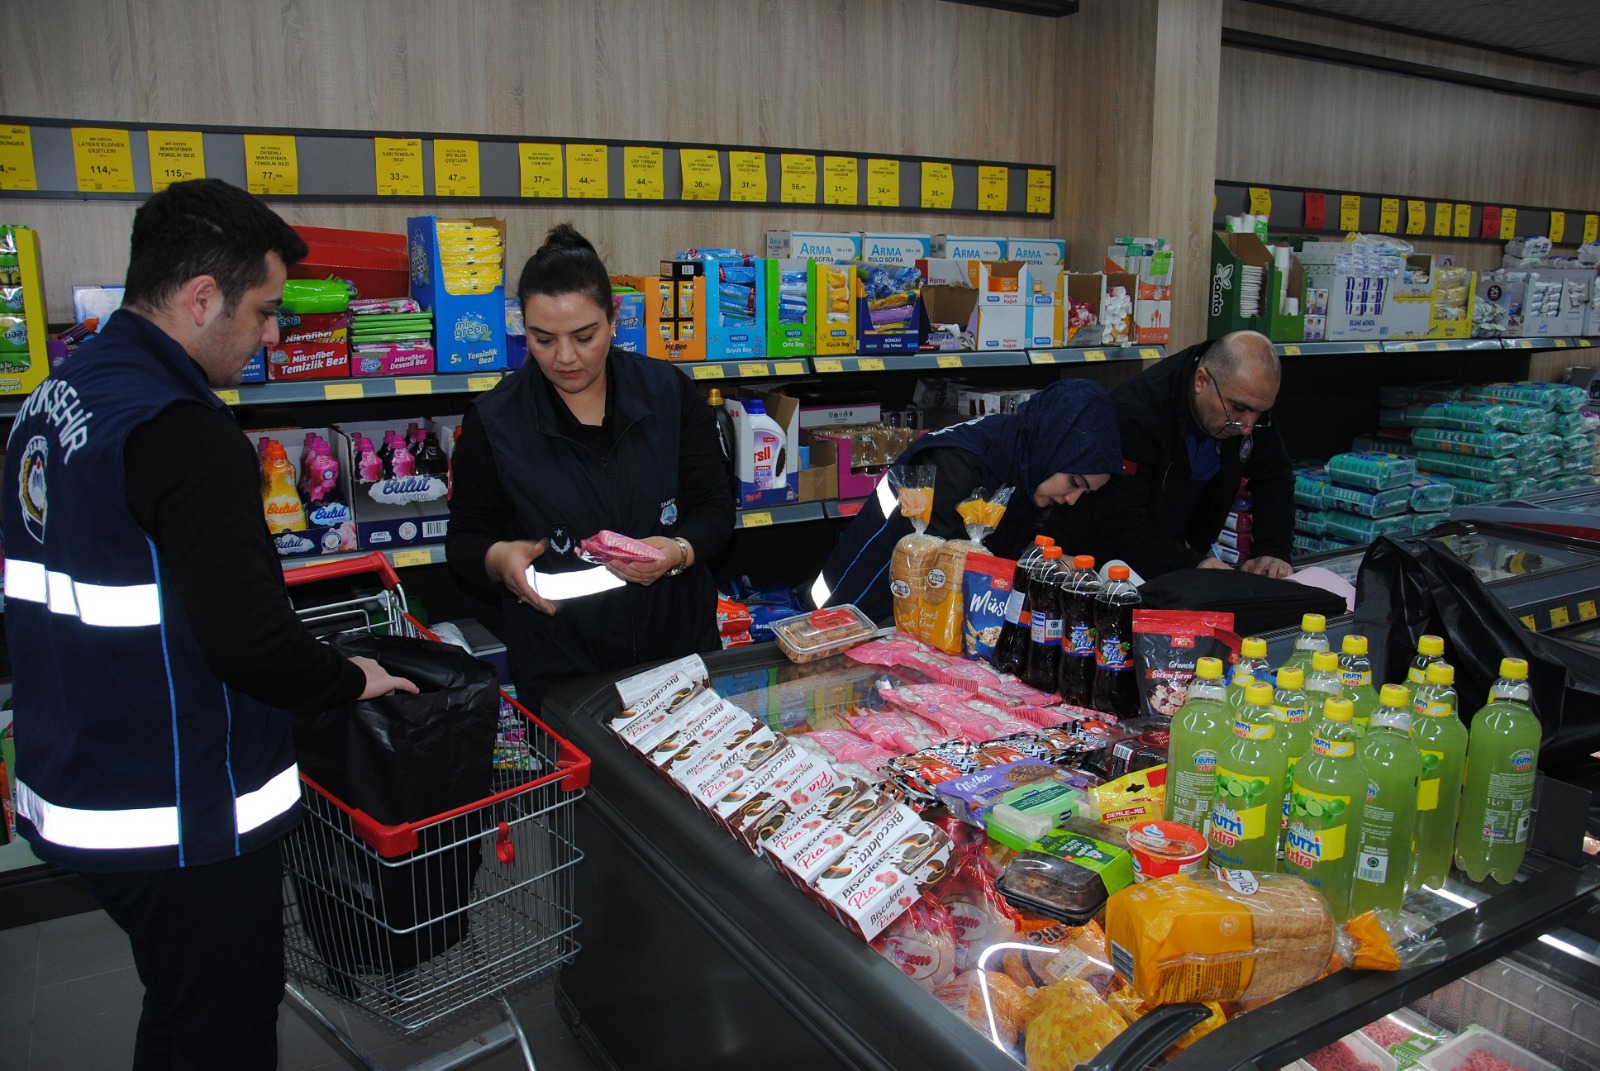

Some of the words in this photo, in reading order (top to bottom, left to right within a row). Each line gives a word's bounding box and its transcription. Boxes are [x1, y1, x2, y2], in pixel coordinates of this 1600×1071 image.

[800, 242, 832, 255] ARMA
[871, 244, 901, 256] ARMA
[953, 246, 981, 258] ARMA
[1015, 247, 1041, 259] ARMA
[1212, 275, 1223, 316] santa
[454, 324, 489, 341] green
[292, 350, 336, 363] Mikrofiber
[394, 353, 426, 363] Mikrofiber
[468, 349, 498, 361] Temizlik
[478, 356, 494, 365] Bezi
[742, 346, 752, 355] Boy
[281, 359, 324, 375] Temizlik
[326, 354, 348, 367] Bezi
[390, 359, 415, 370] Desenli
[416, 358, 428, 366] Bez
[382, 475, 431, 495] Bulut
[266, 502, 300, 514] Bulut
[315, 507, 348, 520] Bulut
[276, 538, 304, 549] Bulut
[1168, 660, 1195, 670] Granola
[642, 674, 680, 710] Biscolata
[625, 701, 666, 733] Biscolata
[684, 702, 725, 742] Biscolata
[627, 722, 650, 738] Pia
[685, 748, 717, 777] Biscolata
[692, 762, 709, 776] Pia
[753, 747, 798, 793] Biscolata
[783, 762, 814, 794] Biscolata
[807, 770, 834, 793] Pia
[955, 773, 994, 792] Milka
[701, 779, 727, 799] Pia
[771, 802, 819, 844] Biscolata
[774, 829, 804, 851] Pia
[792, 816, 839, 862] Biscolata
[857, 811, 905, 867] Biscolata
[1210, 827, 1235, 848] extra
[796, 846, 827, 870] Pia
[1286, 847, 1313, 869] extra
[841, 851, 890, 899] Biscolata
[847, 883, 879, 910] Pia
[869, 883, 907, 926] Biscolata
[876, 909, 898, 929] Pia
